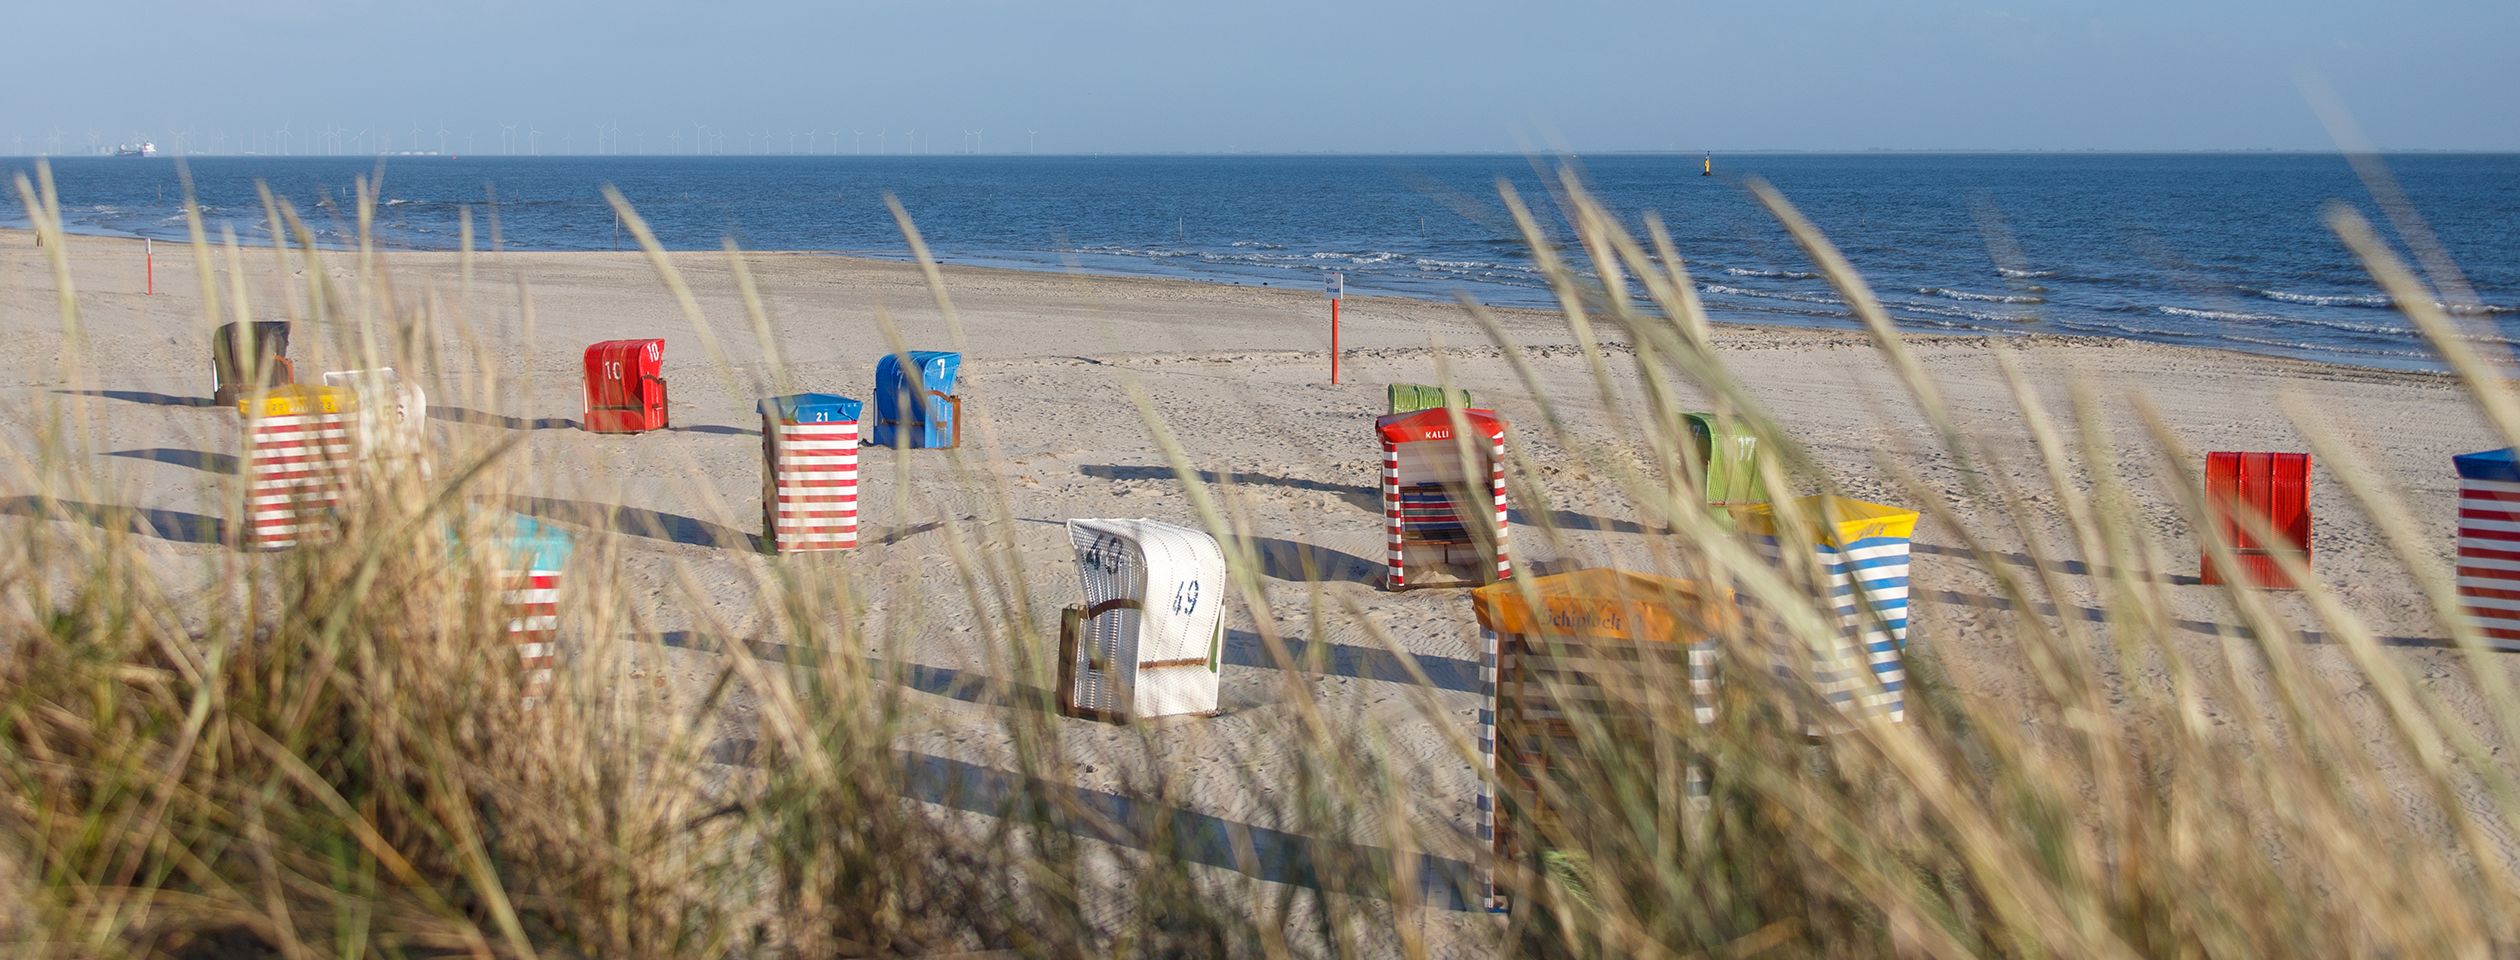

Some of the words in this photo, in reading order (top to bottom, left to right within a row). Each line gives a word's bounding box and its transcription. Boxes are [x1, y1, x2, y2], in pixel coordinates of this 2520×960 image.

[647, 342, 659, 362] 10
[605, 361, 621, 380] 10
[937, 358, 946, 379] 7
[816, 412, 829, 422] 21
[1737, 436, 1758, 461] 17
[1172, 579, 1199, 616] 49
